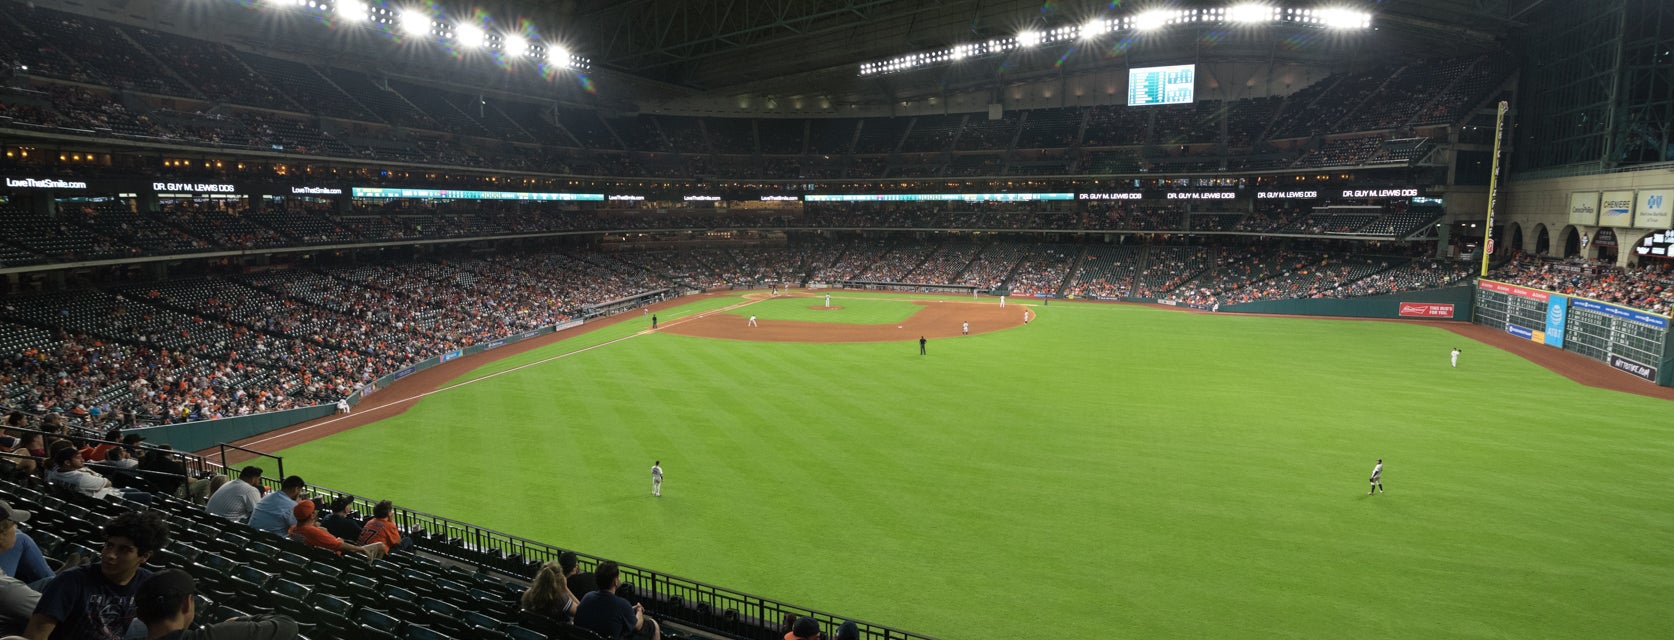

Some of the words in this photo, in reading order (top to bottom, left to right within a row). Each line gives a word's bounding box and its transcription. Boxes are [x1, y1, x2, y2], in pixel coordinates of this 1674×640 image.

[6, 177, 87, 189] LoveThatSmile.com
[153, 182, 167, 191] DR.
[167, 182, 183, 191] GUY
[184, 183, 193, 191] M.
[194, 183, 218, 192] LEWIS
[218, 184, 235, 192] DDS
[291, 186, 342, 194] LoveThatSmile.com
[1342, 190, 1353, 198] DR.
[1378, 189, 1400, 197] LEWIS
[1401, 189, 1418, 197] DDS
[1603, 200, 1631, 208] CHENIERE
